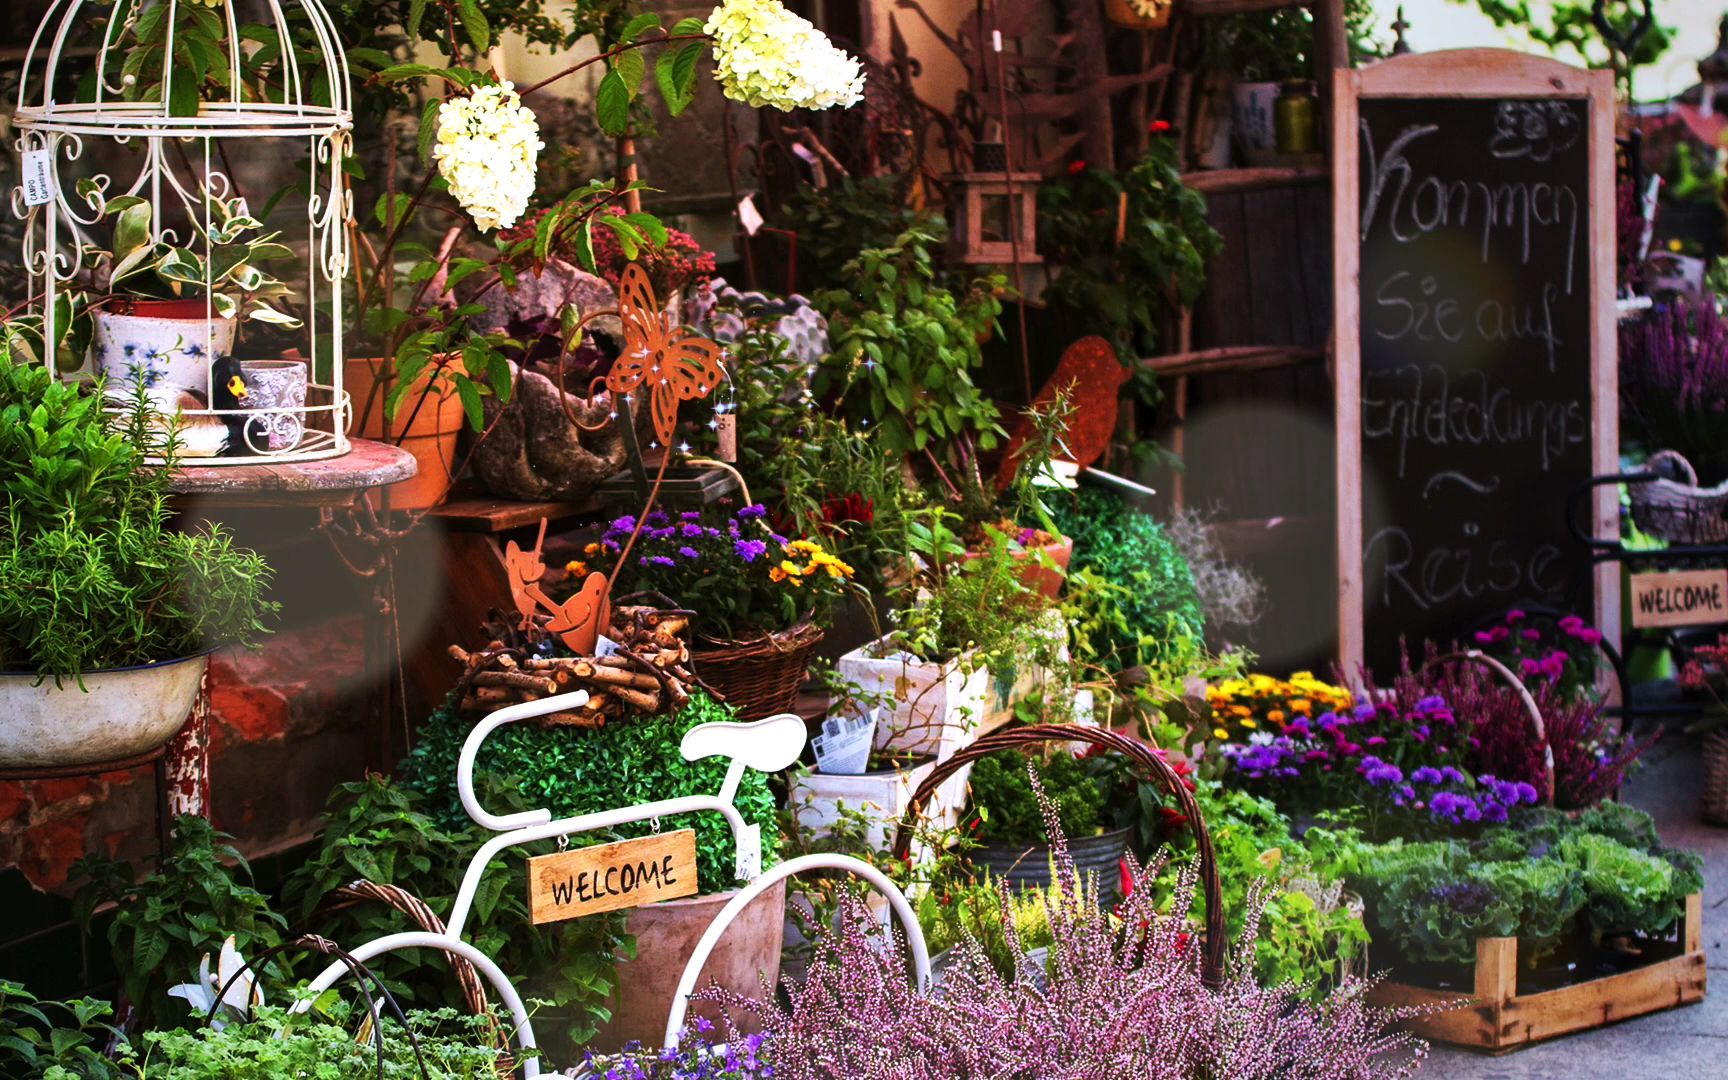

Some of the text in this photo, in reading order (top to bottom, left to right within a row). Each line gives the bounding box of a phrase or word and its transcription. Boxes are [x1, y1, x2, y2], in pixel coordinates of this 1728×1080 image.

[28, 179, 38, 201] CAMPO
[1360, 117, 1577, 295] Kommen
[1377, 271, 1560, 372] Sie auf
[1363, 526, 1564, 610] Reise
[1639, 583, 1722, 614] WELCOME
[552, 855, 677, 905] WELCOME
